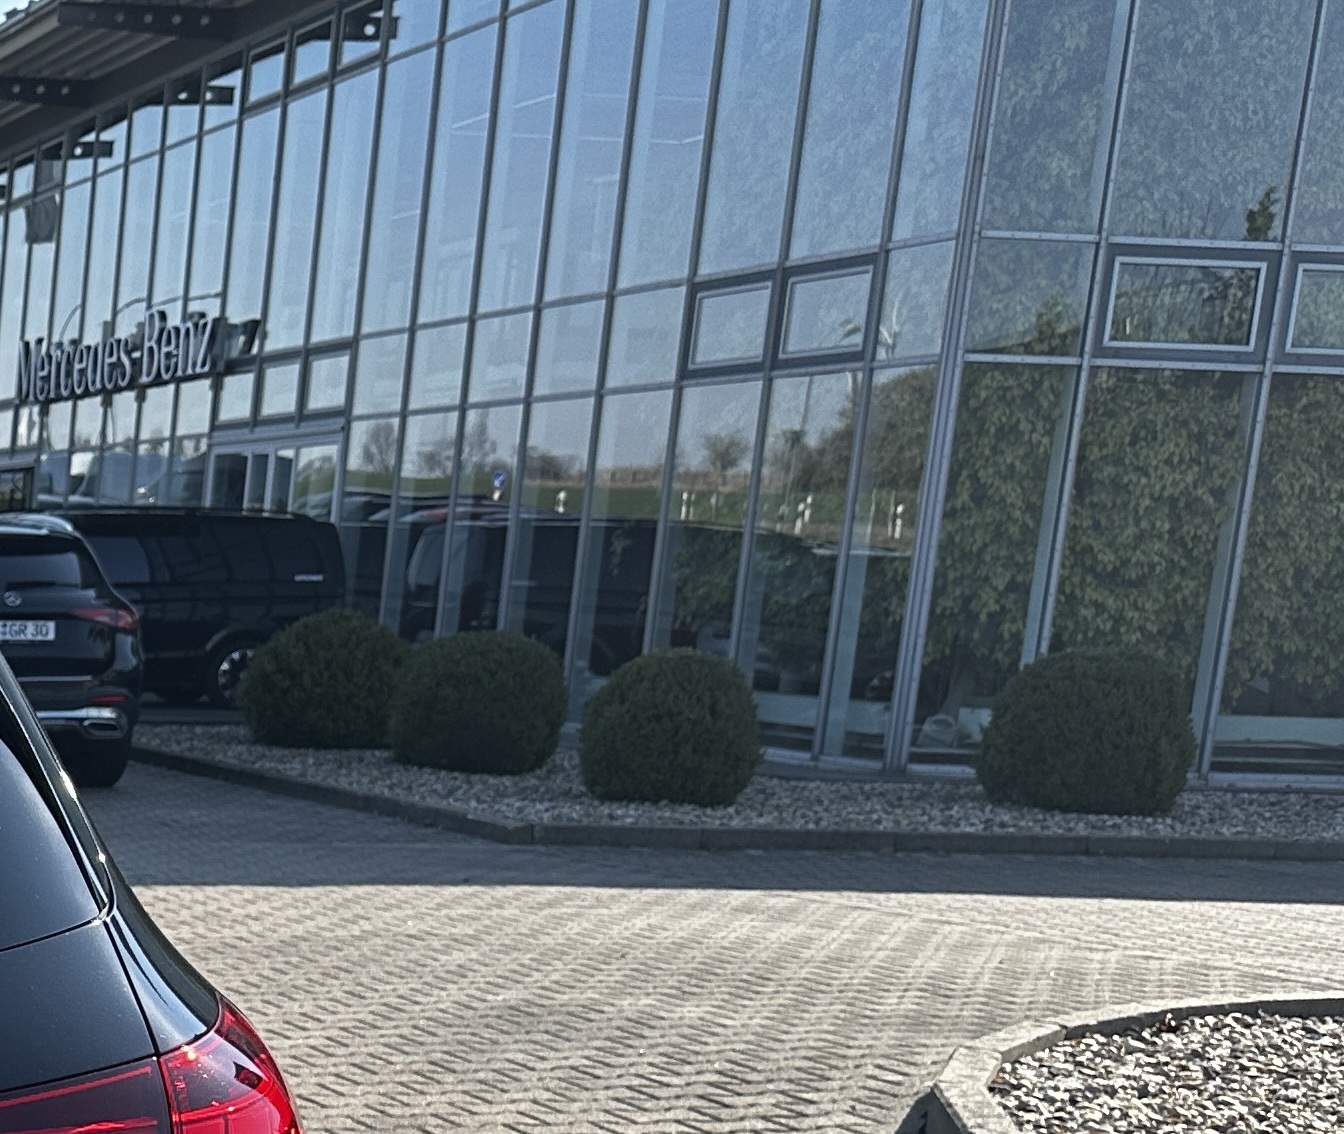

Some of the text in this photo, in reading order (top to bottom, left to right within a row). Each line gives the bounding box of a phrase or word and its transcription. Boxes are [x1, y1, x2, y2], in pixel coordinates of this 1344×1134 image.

[16, 308, 214, 402] Mercedes-Benz
[9, 624, 27, 638] GR
[31, 624, 49, 637] 30
